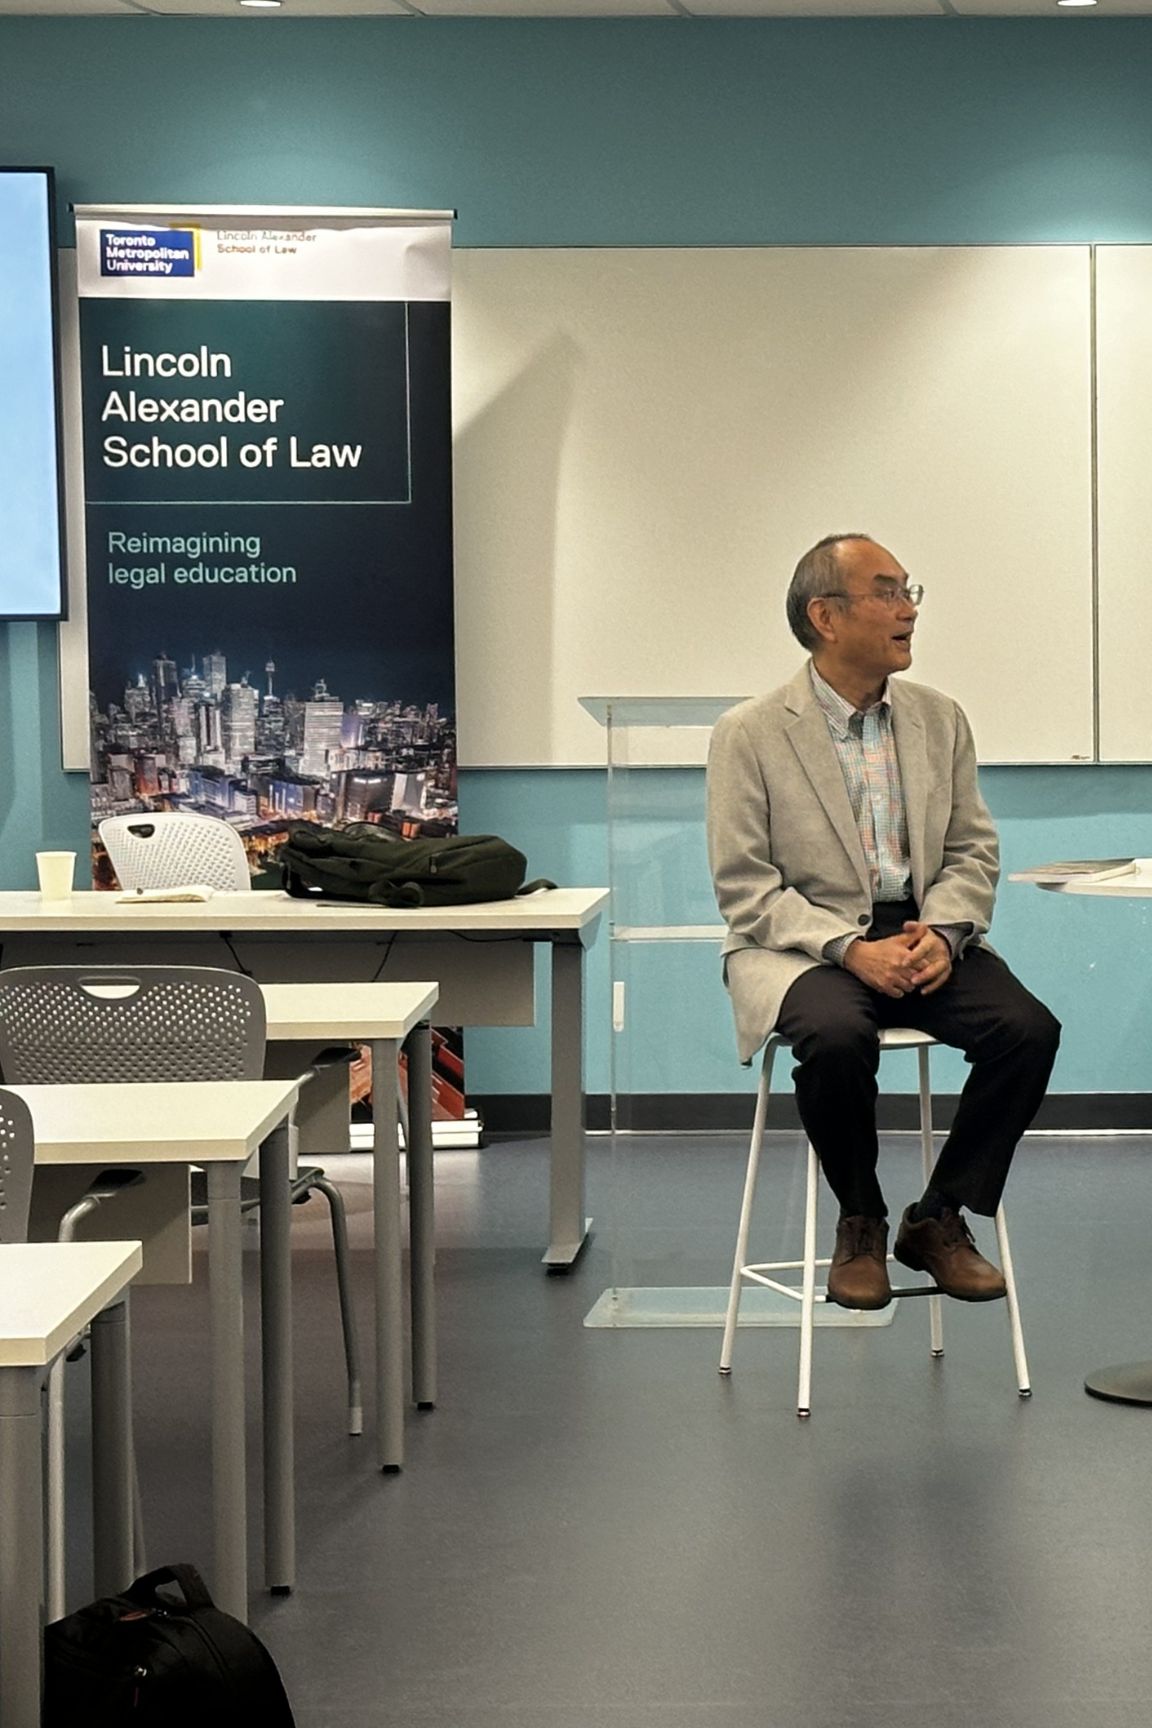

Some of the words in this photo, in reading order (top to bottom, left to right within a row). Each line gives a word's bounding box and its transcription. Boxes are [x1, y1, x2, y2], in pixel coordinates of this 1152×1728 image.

[105, 233, 156, 247] Toronto
[216, 230, 258, 241] Lincoln
[106, 247, 190, 261] Metropolitan
[216, 243, 256, 254] School
[260, 243, 271, 254] of
[274, 244, 297, 254] Law
[106, 260, 174, 274] University
[102, 345, 232, 378] Lincoln
[101, 390, 285, 423] Alexander
[103, 435, 228, 468] School
[239, 437, 278, 468] of
[290, 436, 362, 468] Law
[108, 531, 261, 559] Reimagining
[108, 562, 165, 590] legal
[173, 562, 297, 583] education
